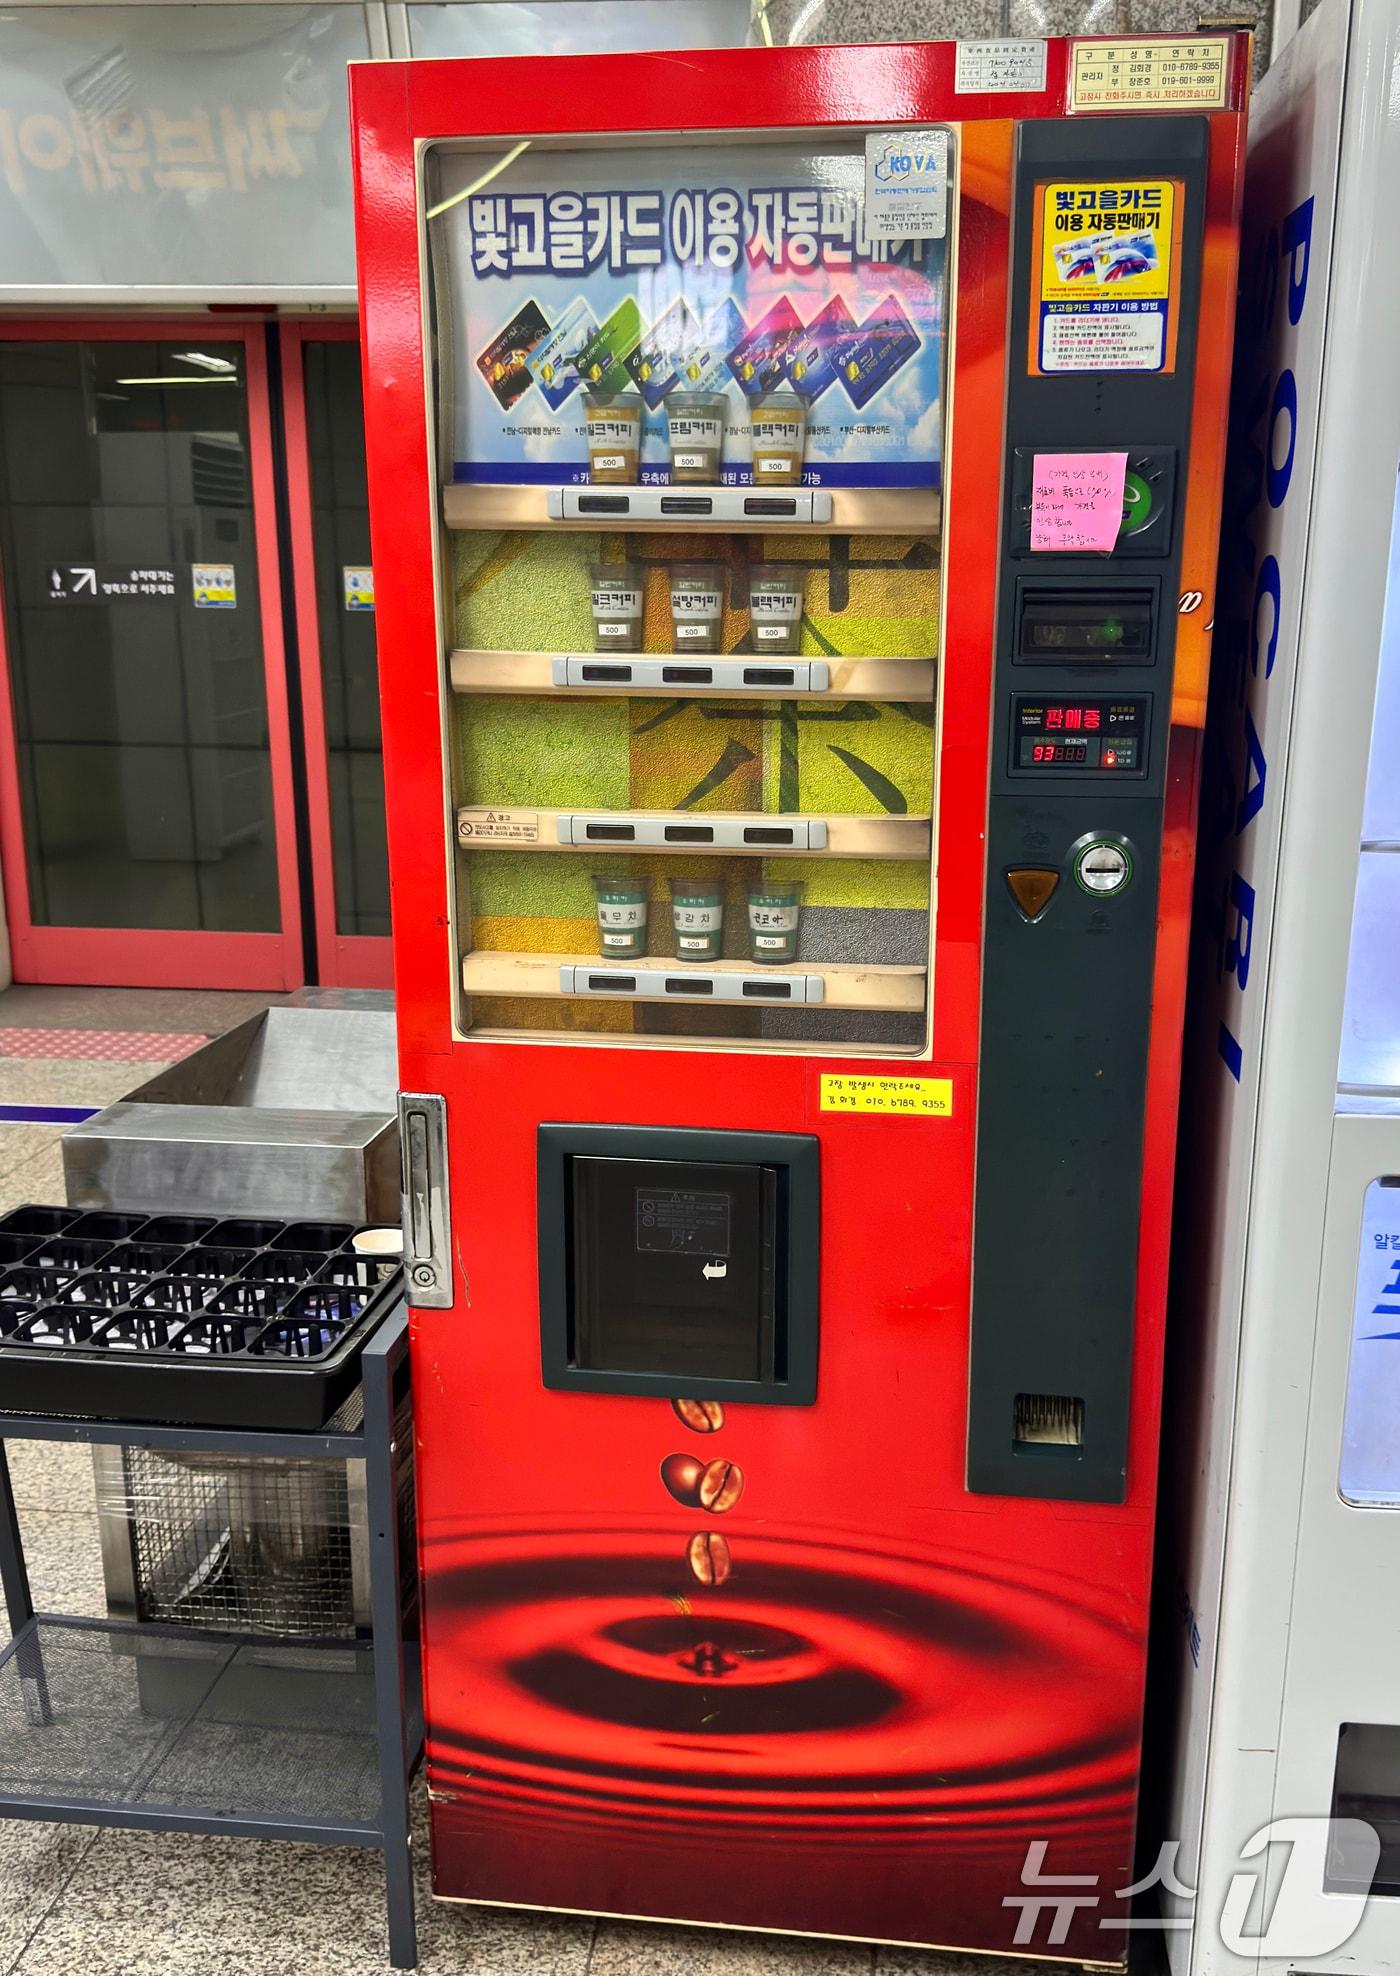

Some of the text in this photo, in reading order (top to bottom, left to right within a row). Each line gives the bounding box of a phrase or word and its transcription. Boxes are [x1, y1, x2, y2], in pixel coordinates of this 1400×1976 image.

[1162, 63, 1220, 71] 010-6789-9355
[1081, 73, 1104, 81] 관리자
[1161, 76, 1215, 85] 019-601-9999
[1079, 92, 1102, 102] 고장시
[1104, 91, 1142, 101] 전화주시면
[1164, 89, 1216, 99] 처리하겠습니다
[890, 155, 937, 172] KOVA
[1056, 189, 1162, 211] 빛고을카드
[1055, 212, 1161, 231] 이용 자동판매기
[471, 192, 663, 273] 빛고을카드
[672, 188, 741, 271] 이용
[1048, 302, 1159, 313] 빛고을카드 자판기 이용 방법
[587, 423, 632, 437] 밀크커피
[670, 421, 717, 436] 프림커피
[752, 423, 799, 438] 블랙커피
[602, 458, 617, 467] 500
[681, 457, 695, 466] 500
[768, 462, 783, 471] 500
[640, 472, 671, 484] 우측에
[591, 593, 636, 606] 밀크커피
[672, 594, 718, 608] 설탕커피
[750, 595, 797, 608] 블랙커피
[605, 626, 620, 635] 500
[684, 627, 699, 637] 500
[764, 628, 779, 638] 500
[1218, 195, 1315, 1084] POCARI
[1046, 709, 1101, 729] 판매중
[610, 937, 624, 946] 500
[687, 940, 700, 949] 500
[763, 938, 777, 947] 500
[828, 1079, 843, 1090] 고장
[848, 1080, 875, 1091] 발생시
[921, 1099, 946, 1109] 9355
